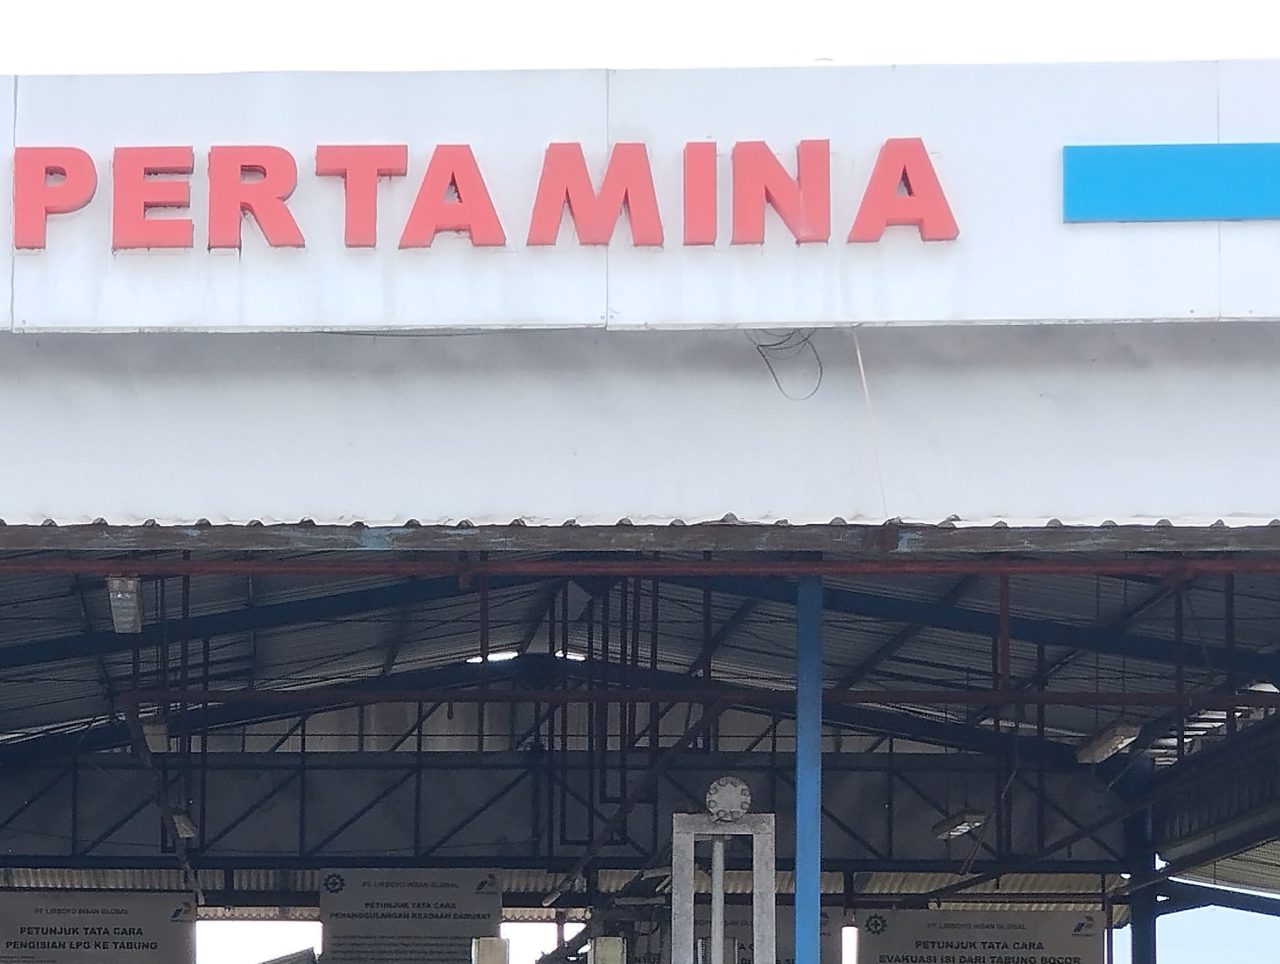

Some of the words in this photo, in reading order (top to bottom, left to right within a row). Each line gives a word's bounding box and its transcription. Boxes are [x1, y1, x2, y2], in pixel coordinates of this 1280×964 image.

[13, 137, 959, 251] PERTAMINA
[20, 927, 79, 936] PETUNJUK
[83, 927, 111, 936] TATA
[113, 927, 144, 936] CARA
[5, 940, 67, 950] PENGISIAN
[70, 941, 92, 950] LPG
[94, 941, 110, 950] KE
[112, 941, 158, 950] TABUNG
[915, 940, 978, 950] PETUNJUK
[980, 941, 1009, 950] TATA
[1012, 941, 1045, 951] CARA
[878, 954, 937, 964] EVAKUASI
[940, 955, 956, 964] ISI
[959, 955, 986, 964] DARI
